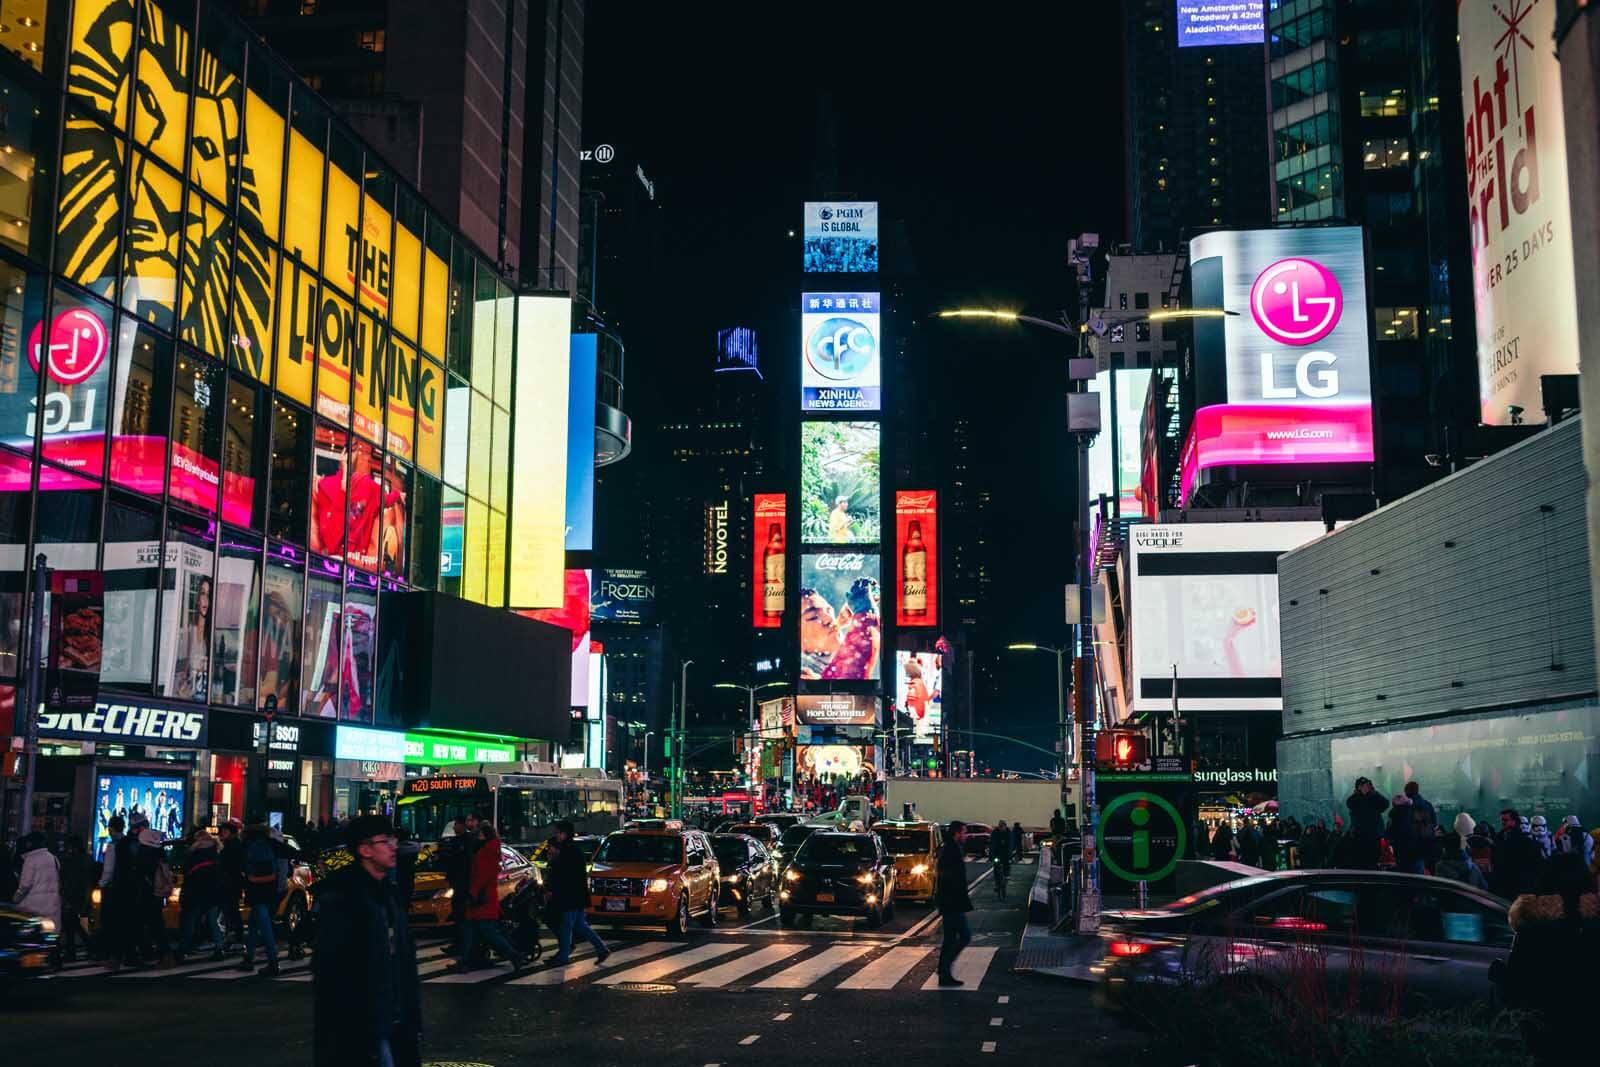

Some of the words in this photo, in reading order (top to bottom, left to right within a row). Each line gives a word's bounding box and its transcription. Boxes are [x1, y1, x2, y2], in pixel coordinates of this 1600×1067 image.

[1477, 151, 1494, 179] THE
[836, 208, 863, 219] PGIM
[821, 222, 830, 232] IS
[832, 222, 861, 232] GLOBAL
[1505, 248, 1518, 276] 25
[1522, 220, 1553, 261] DAYS
[346, 223, 389, 297] THE
[810, 298, 872, 309] 新华通讯社
[289, 248, 366, 377] LION
[369, 307, 435, 421] KING
[1261, 351, 1340, 399] LG
[819, 390, 863, 400] XINHUA
[809, 401, 836, 409] NEWS
[838, 401, 873, 409] AGENCY
[1267, 429, 1332, 439] www.LG.com
[715, 501, 728, 573] NOVOTEL
[601, 581, 655, 600] FROZEN
[430, 780, 453, 791] SOUTH
[455, 779, 477, 789] FERRY
[1194, 768, 1252, 785] sunglass
[1255, 768, 1277, 782] hut
